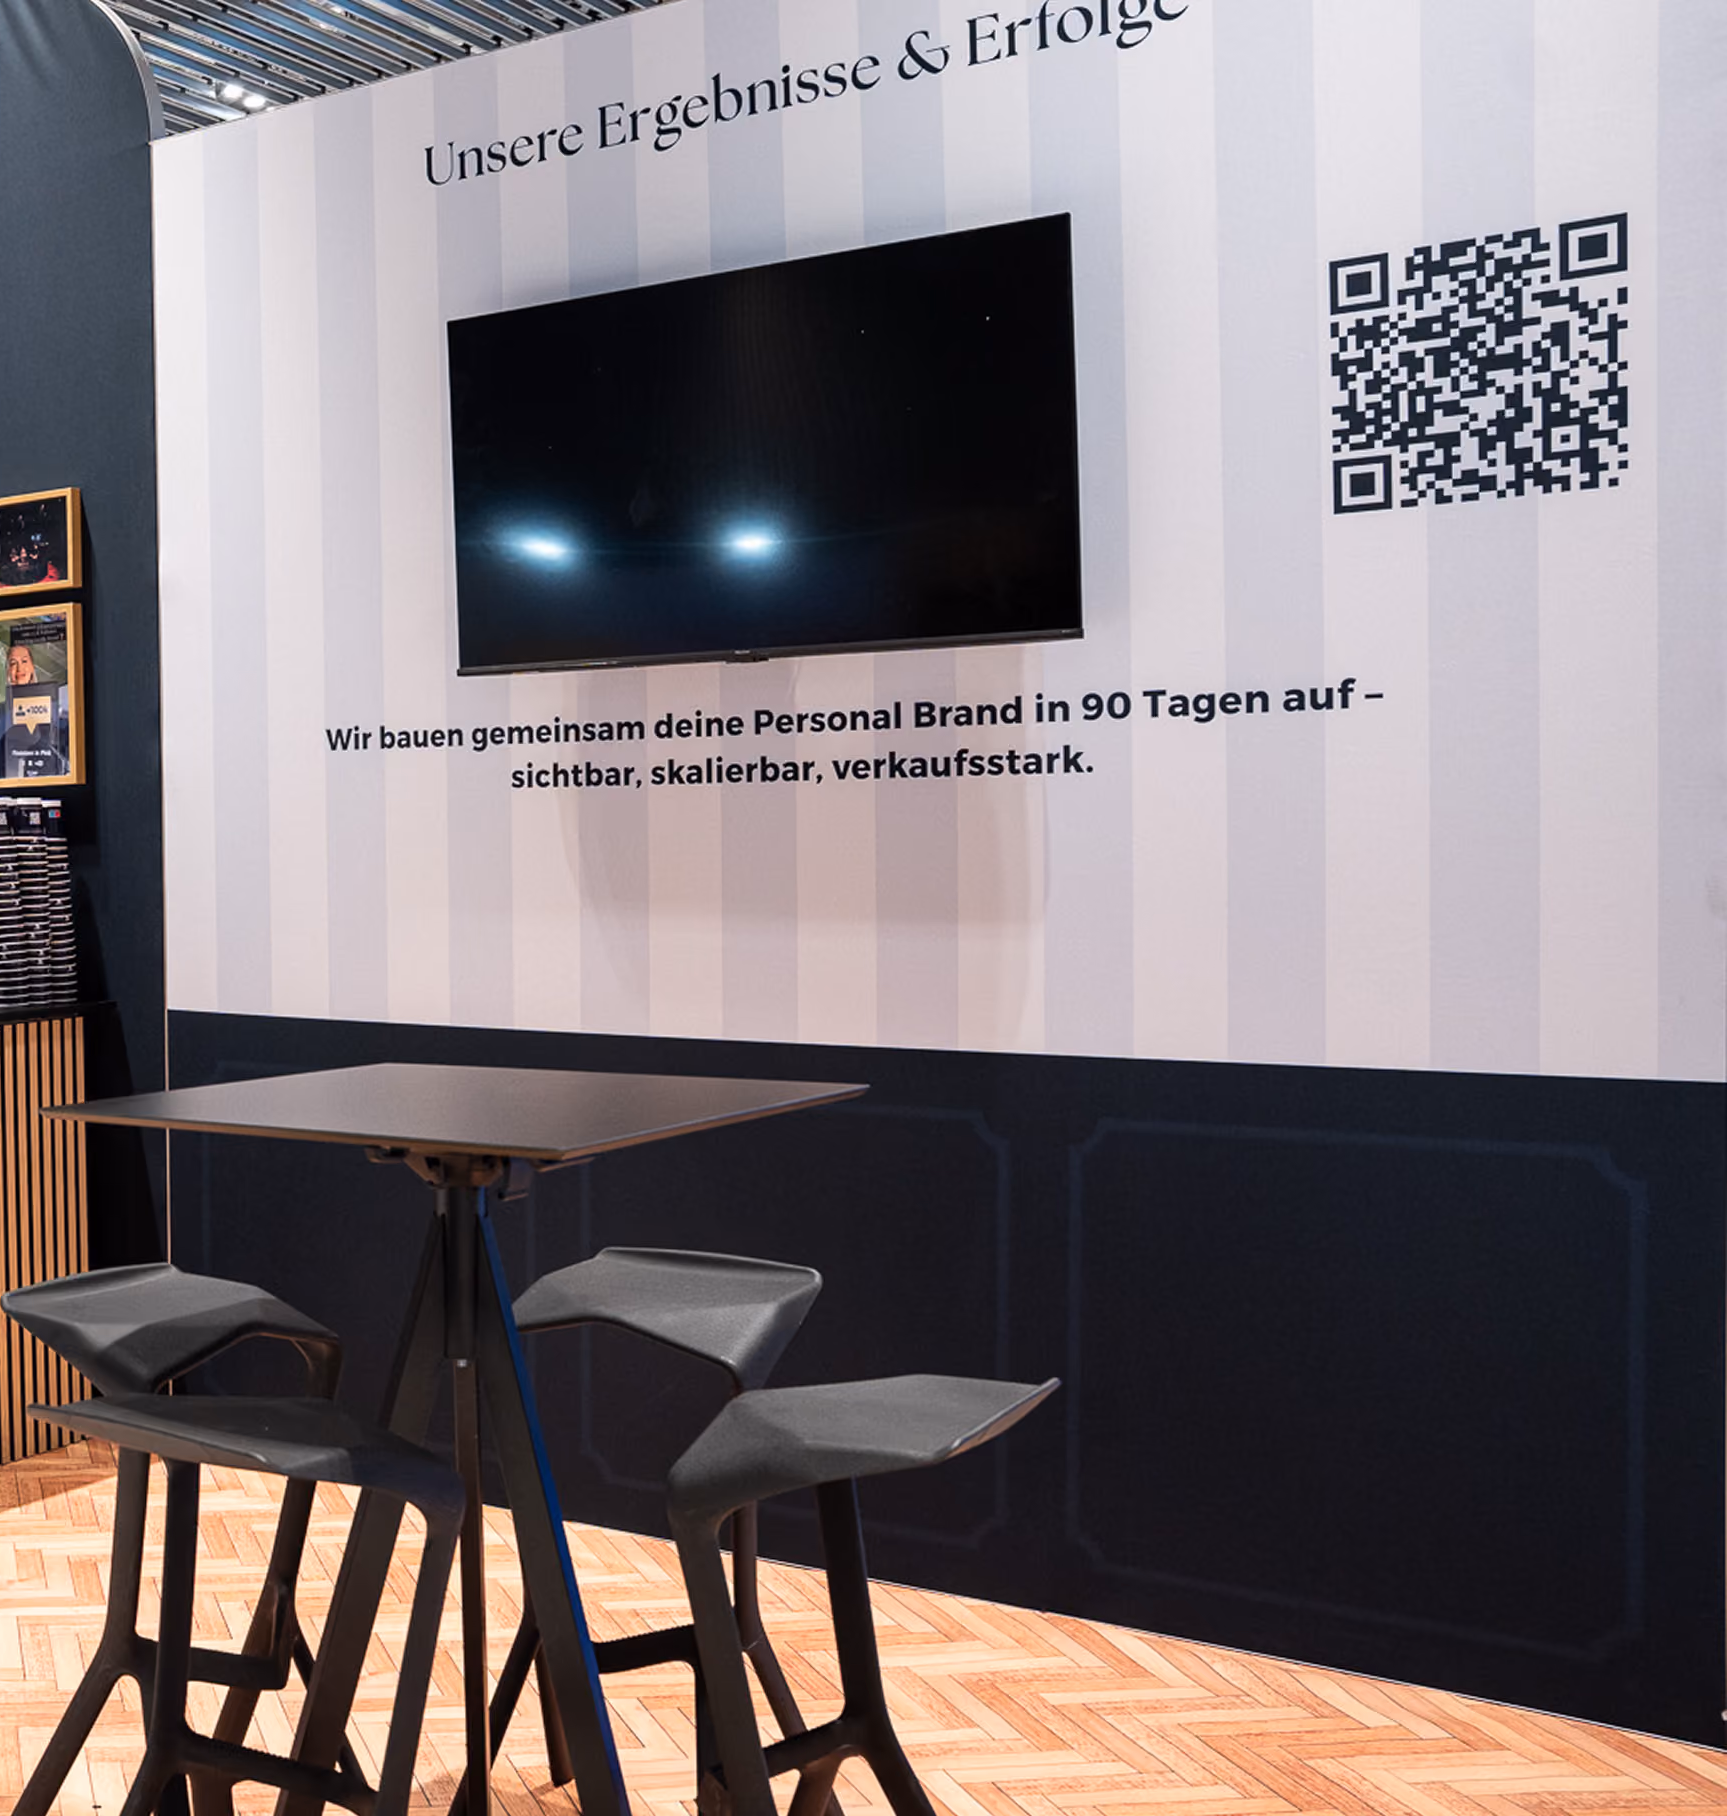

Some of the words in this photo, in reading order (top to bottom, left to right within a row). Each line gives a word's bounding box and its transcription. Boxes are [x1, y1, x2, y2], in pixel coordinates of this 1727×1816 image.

[424, 122, 585, 188] Unsere
[597, 54, 882, 153] Ergebnisse
[898, 30, 951, 81] &
[326, 727, 372, 751] Wir
[379, 726, 464, 750] bauen
[471, 716, 646, 752] gemeinsam
[654, 712, 745, 740] deine
[754, 701, 902, 736] Personal
[913, 696, 1023, 729] Brand
[1035, 693, 1071, 723] in
[1081, 691, 1132, 721] 90
[1142, 688, 1270, 723] Tagen
[1282, 678, 1357, 711] auf
[510, 762, 644, 789] sichtbar,
[651, 757, 824, 785] skalierbar,
[833, 745, 1094, 780] verkaufsstark.
